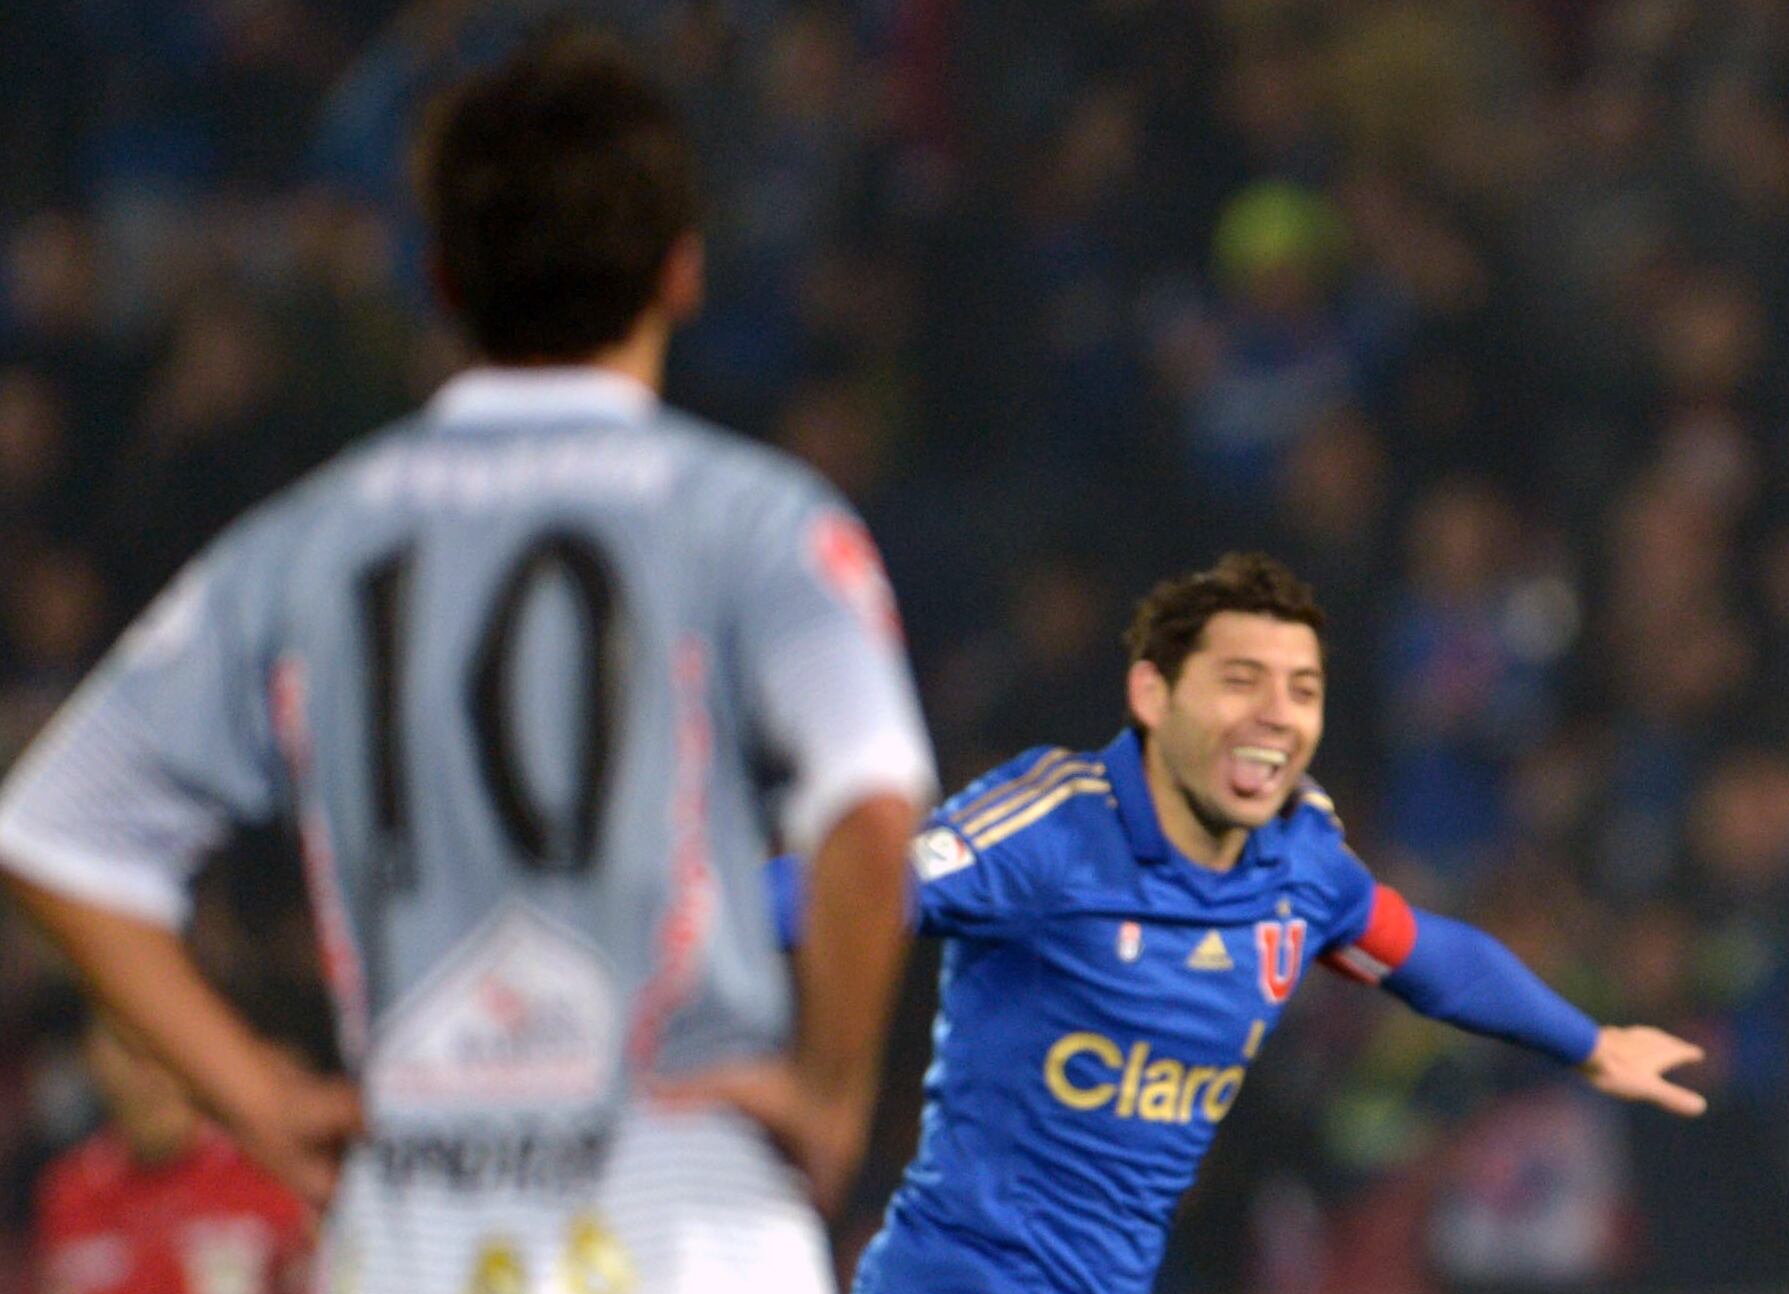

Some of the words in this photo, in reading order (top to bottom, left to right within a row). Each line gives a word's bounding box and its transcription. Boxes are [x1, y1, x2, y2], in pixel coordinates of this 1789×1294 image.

[352, 523, 628, 892] 10
[1256, 918, 1306, 1003] U
[1044, 1032, 1245, 1124] Claro
